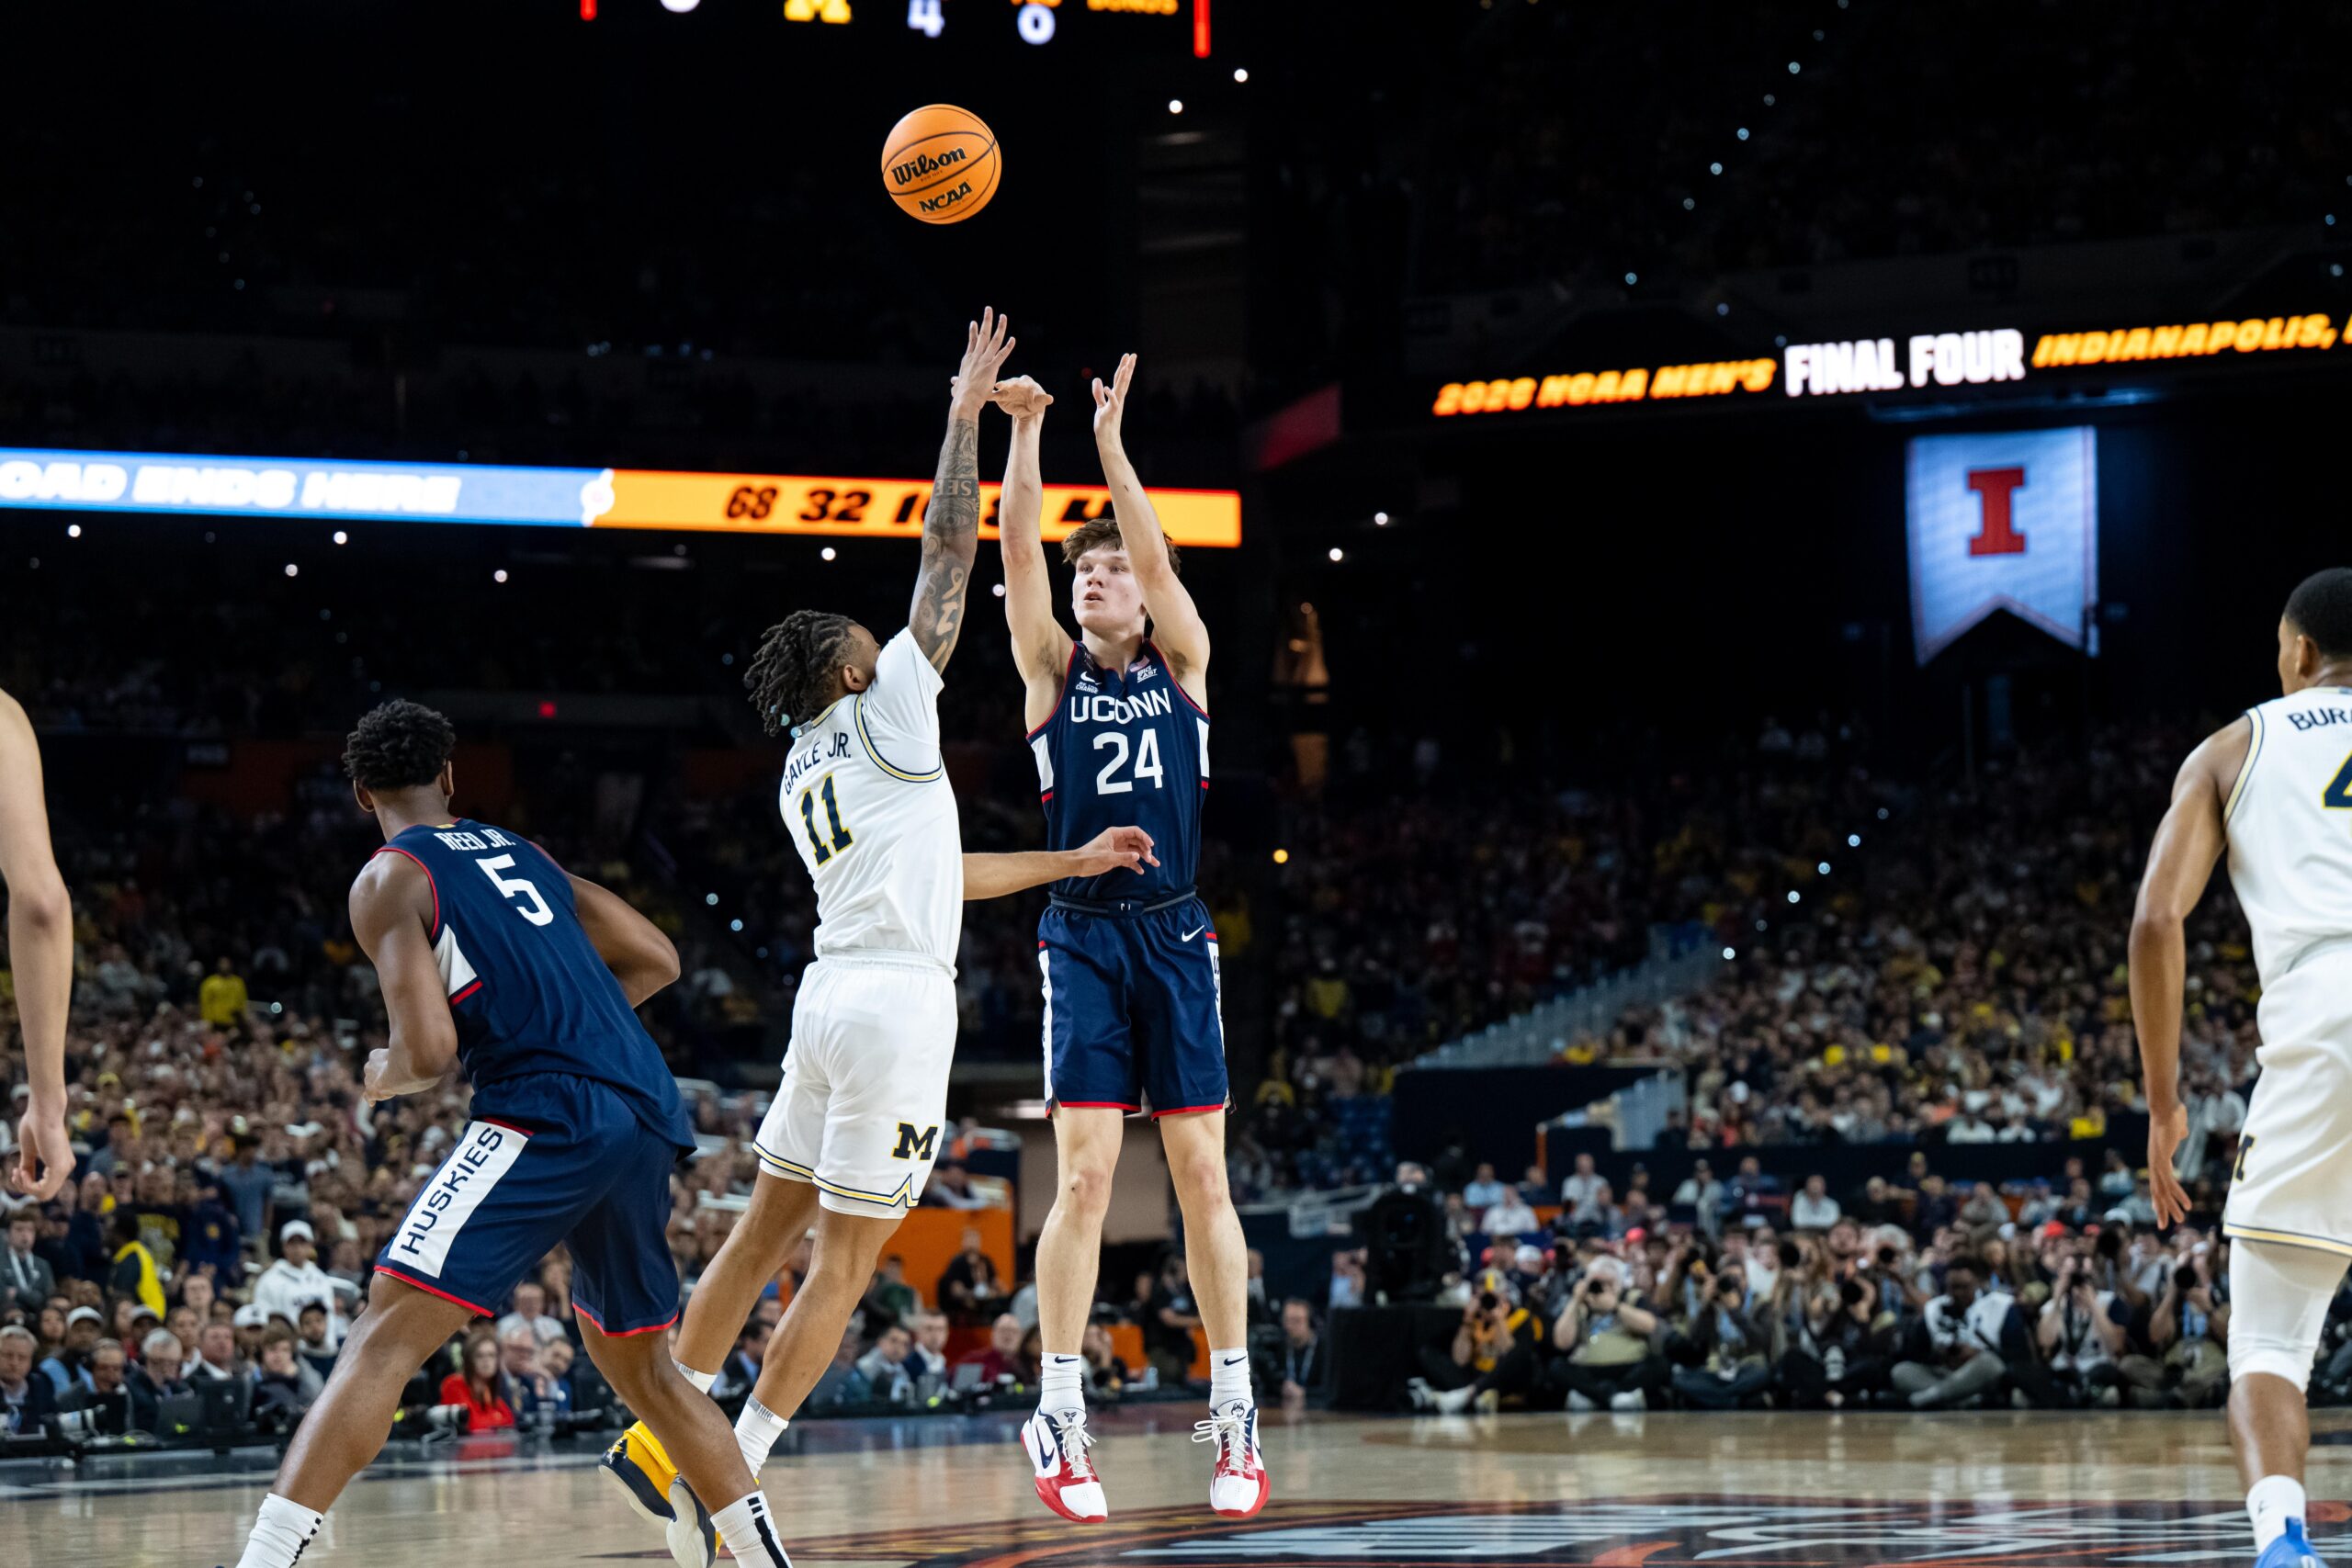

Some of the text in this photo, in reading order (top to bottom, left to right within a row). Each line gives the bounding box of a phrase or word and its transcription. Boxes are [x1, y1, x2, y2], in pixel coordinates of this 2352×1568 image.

[891, 147, 967, 186] Wilson
[919, 181, 972, 212] NCAA
[1535, 371, 1648, 408] NCAA
[1649, 357, 1777, 400] MEN'S
[1784, 337, 1905, 397] FINAL
[1909, 329, 2026, 388] FOUR
[2031, 313, 2338, 367] INDIANAPOLIS,
[300, 471, 461, 513] HERE
[727, 485, 778, 520] 68
[800, 489, 871, 523] 32
[1968, 466, 2025, 556] I
[1070, 688, 1171, 724] UCONN
[2288, 707, 2352, 730] BUR
[784, 732, 851, 795] GAYLE JR.
[1092, 728, 1163, 795] 24
[433, 829, 516, 851] REED JR.
[800, 772, 854, 867] 11
[475, 853, 554, 926] 5
[891, 1122, 938, 1161] M
[401, 1127, 503, 1255] HUSKIES
